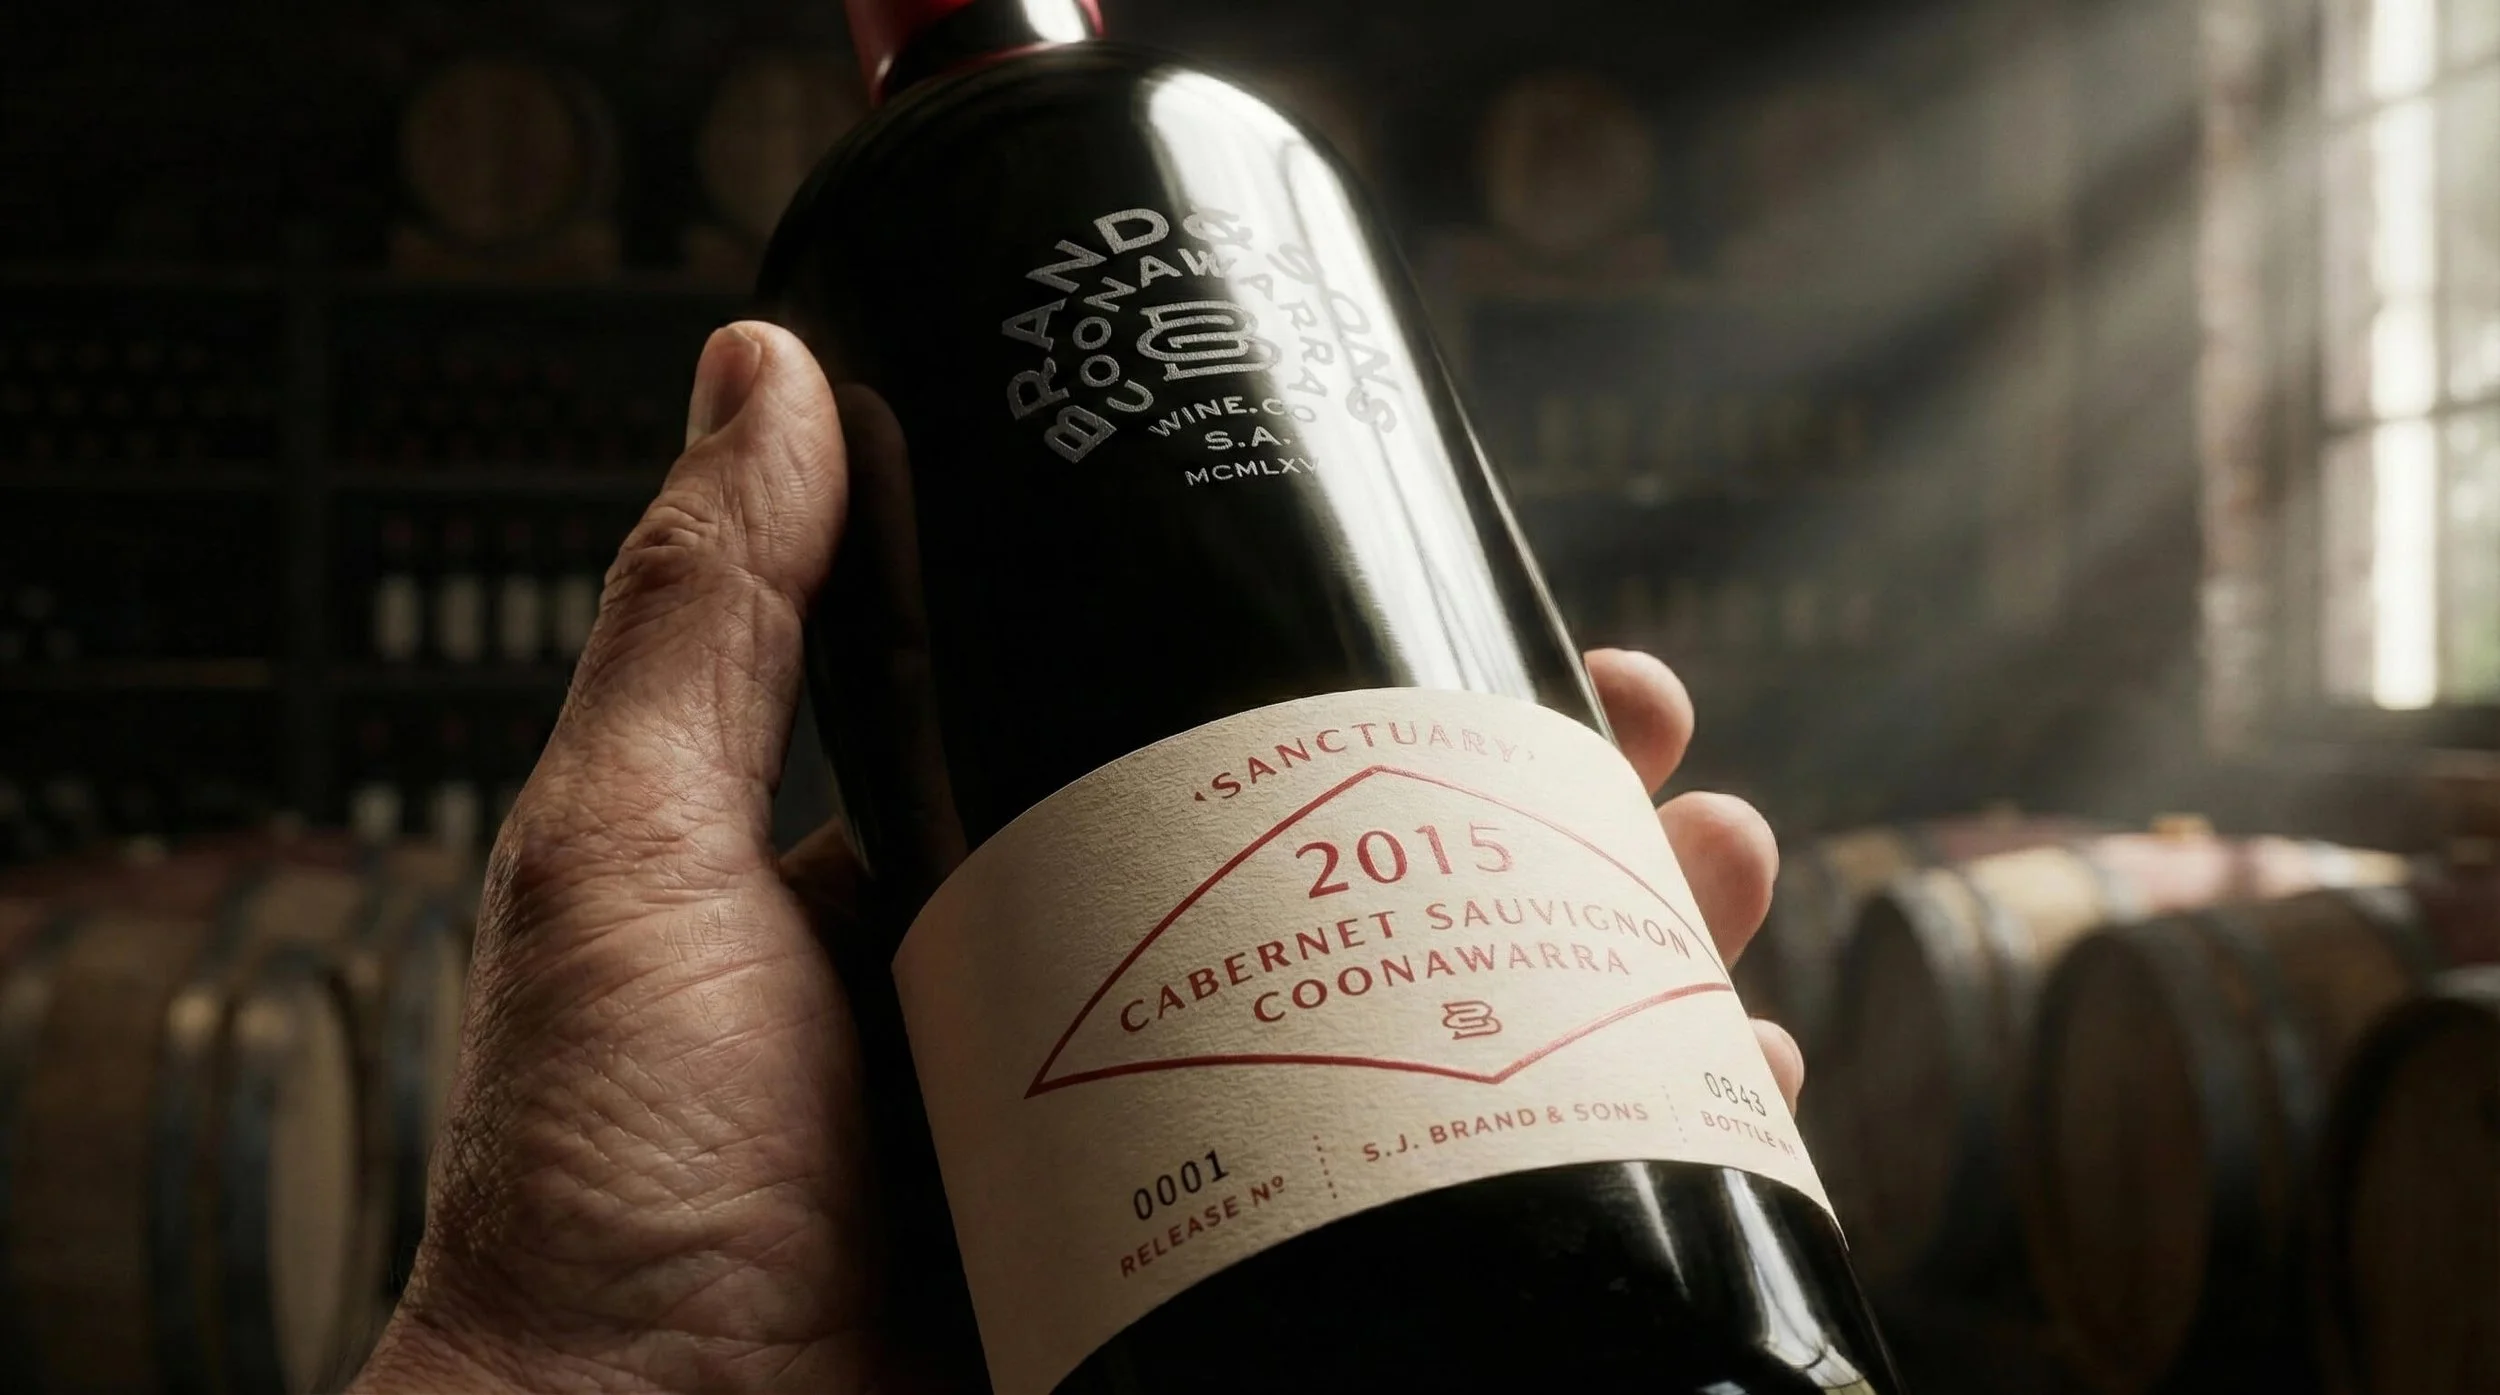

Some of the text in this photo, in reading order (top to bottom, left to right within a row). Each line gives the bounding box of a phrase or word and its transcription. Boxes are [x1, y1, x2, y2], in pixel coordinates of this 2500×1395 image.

[1002, 207, 1170, 464] BRAND
[1182, 204, 1253, 252] &
[1266, 242, 1402, 434] SONS
[1072, 247, 1336, 413] COONAWARRA
[1204, 425, 1291, 451] S.A.
[1295, 821, 1514, 899] 2015
[1120, 910, 1396, 1033] CABERNET
[1425, 897, 1692, 960] SAUVIGNON
[1252, 942, 1631, 1023] COONAWARRA
[1361, 1102, 1650, 1163] S.J. BRAND & SONS
[1700, 1109, 1777, 1149] BOTTLE
[1703, 1071, 1767, 1117] 0843
[1132, 1149, 1230, 1222] 0001
[1119, 1194, 1241, 1278] RELEASE
